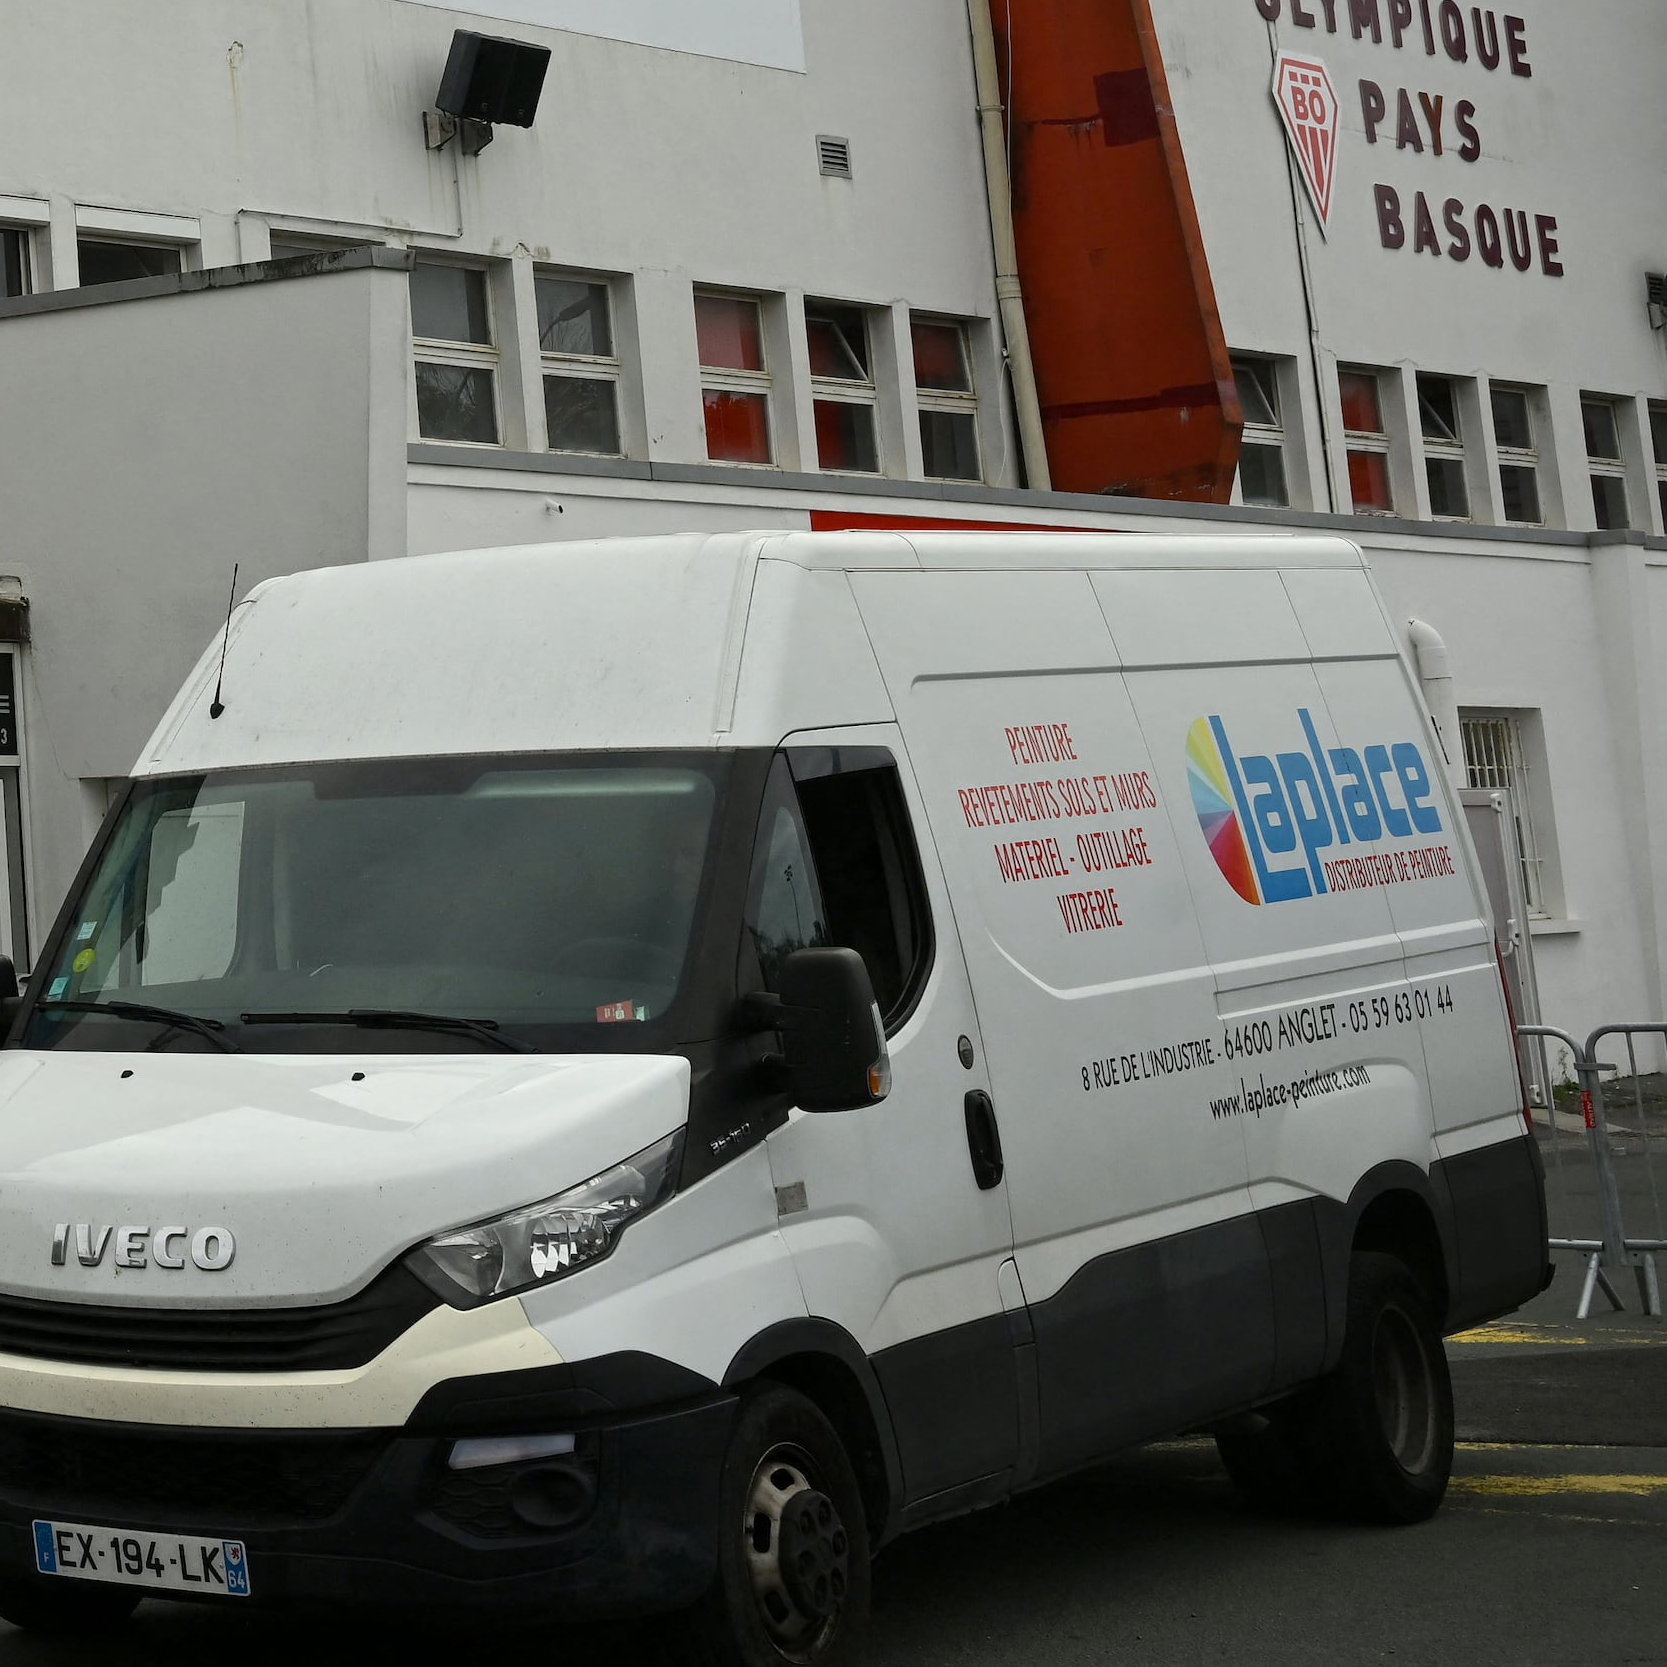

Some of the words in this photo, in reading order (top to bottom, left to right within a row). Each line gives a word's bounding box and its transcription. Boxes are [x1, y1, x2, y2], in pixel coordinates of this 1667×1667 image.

[1290, 85, 1327, 126] BO
[1358, 78, 1482, 163] PAYS
[1373, 183, 1564, 277] BASQUE
[1004, 723, 1078, 766] PEINTURE
[958, 780, 1061, 829] REVETEMENTS
[1058, 776, 1097, 818] SOLS
[1094, 775, 1115, 814] ET
[1111, 770, 1157, 812] MURS
[994, 837, 1070, 884] MATERIEL
[1076, 827, 1153, 874] OUTILLAGE
[1324, 853, 1397, 894] DISTRIBUTEUR
[1396, 853, 1411, 883] DE
[1410, 846, 1456, 881] PEINTURE
[1057, 887, 1124, 934] VITRERIE
[1081, 1066, 1091, 1092] 8
[1092, 1059, 1120, 1091] RUE
[1120, 1055, 1140, 1084] DE
[1142, 1038, 1215, 1079] L'INDUSTRIE
[1223, 1019, 1274, 1061] 64600
[1276, 1002, 1340, 1051] ANGLET
[1349, 1002, 1370, 1034] 05
[1371, 997, 1391, 1029] 59
[1393, 994, 1413, 1024] 63
[1414, 990, 1433, 1021] 01
[1435, 985, 1454, 1015] 44
[1208, 1063, 1371, 1121] www.laplace-peinture.com
[49, 1223, 237, 1272] IVECO
[43, 1552, 50, 1563] F
[56, 1530, 225, 1584] EX-194-LK
[227, 1569, 246, 1590] 64
